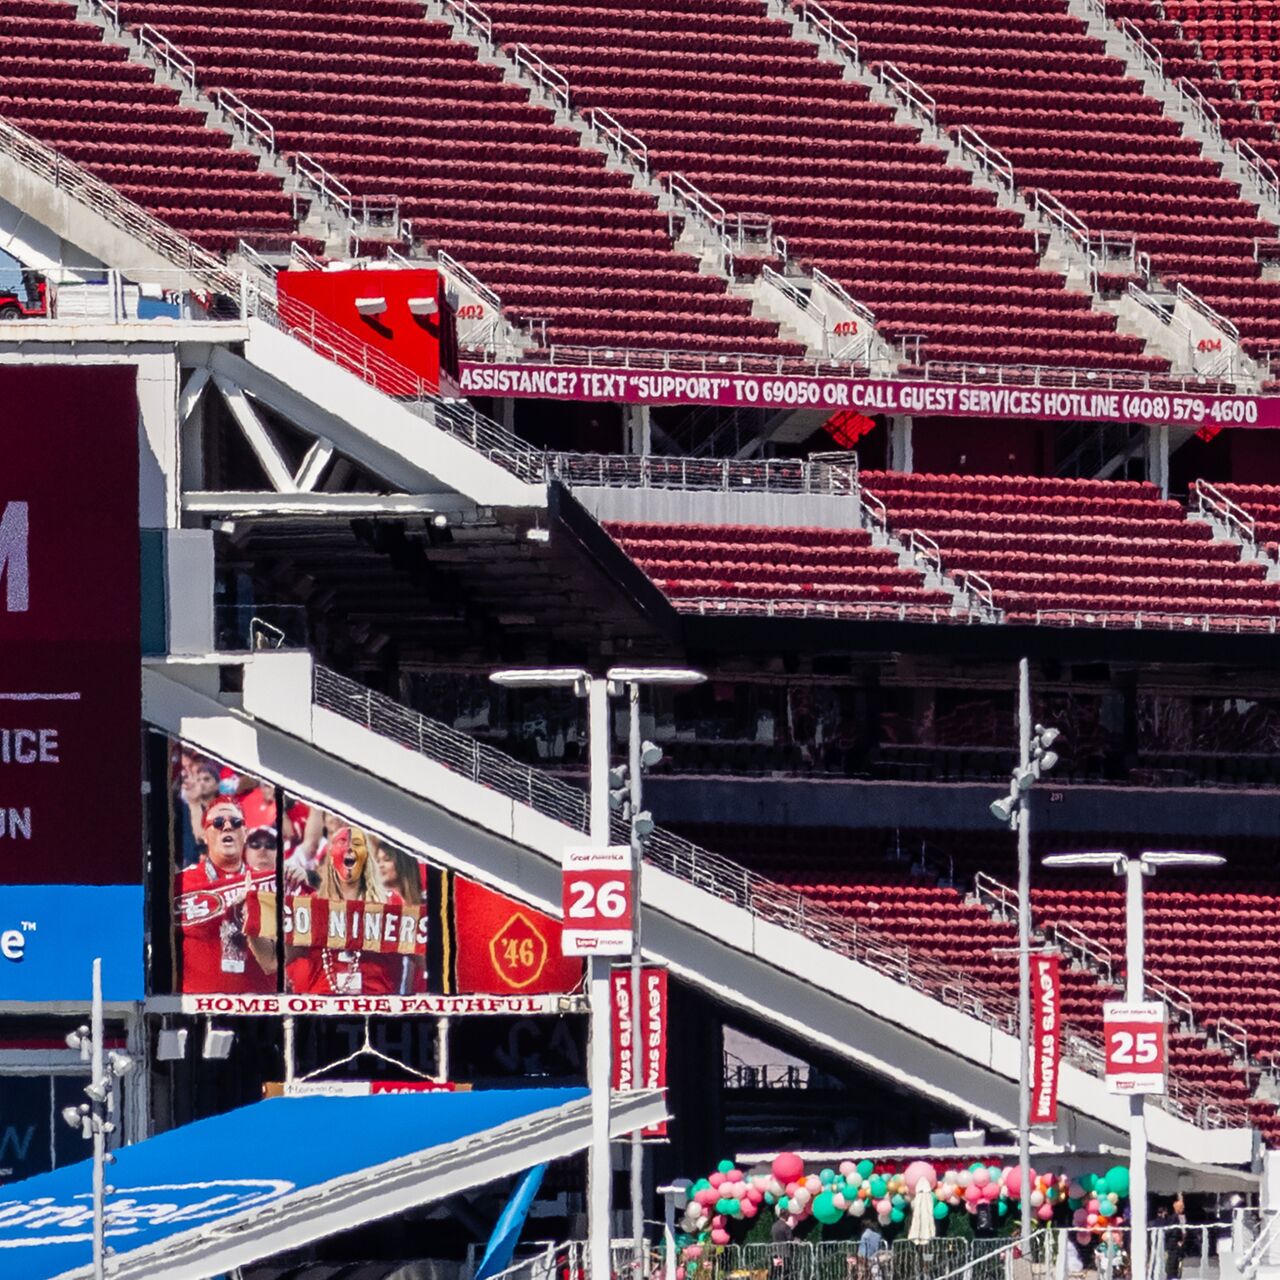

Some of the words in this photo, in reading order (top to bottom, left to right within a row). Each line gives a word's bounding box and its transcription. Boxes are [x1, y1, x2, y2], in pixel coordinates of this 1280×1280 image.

[457, 304, 484, 320] 402
[834, 321, 858, 337] 403
[459, 369, 578, 395] ASSISTANCE?
[580, 373, 627, 398] TEXT
[735, 380, 759, 402] TO
[762, 381, 820, 405] 69050
[823, 382, 849, 406] OR
[852, 384, 897, 409] CALL
[899, 387, 957, 412] GUEST
[959, 389, 1042, 414] SERVICES
[1044, 393, 1120, 418] HOTLINE
[1122, 394, 1170, 420] (408)
[1173, 398, 1258, 424] 579-4600
[569, 880, 627, 918] 26
[283, 904, 310, 934] GO
[329, 911, 428, 944] NINERS
[195, 998, 281, 1013] HOME
[288, 998, 328, 1013] OF
[334, 998, 392, 1013] THE
[400, 998, 543, 1013] FAITHFUL
[1110, 1031, 1158, 1064] 25
[1037, 1034, 1055, 1117] STADIUM
